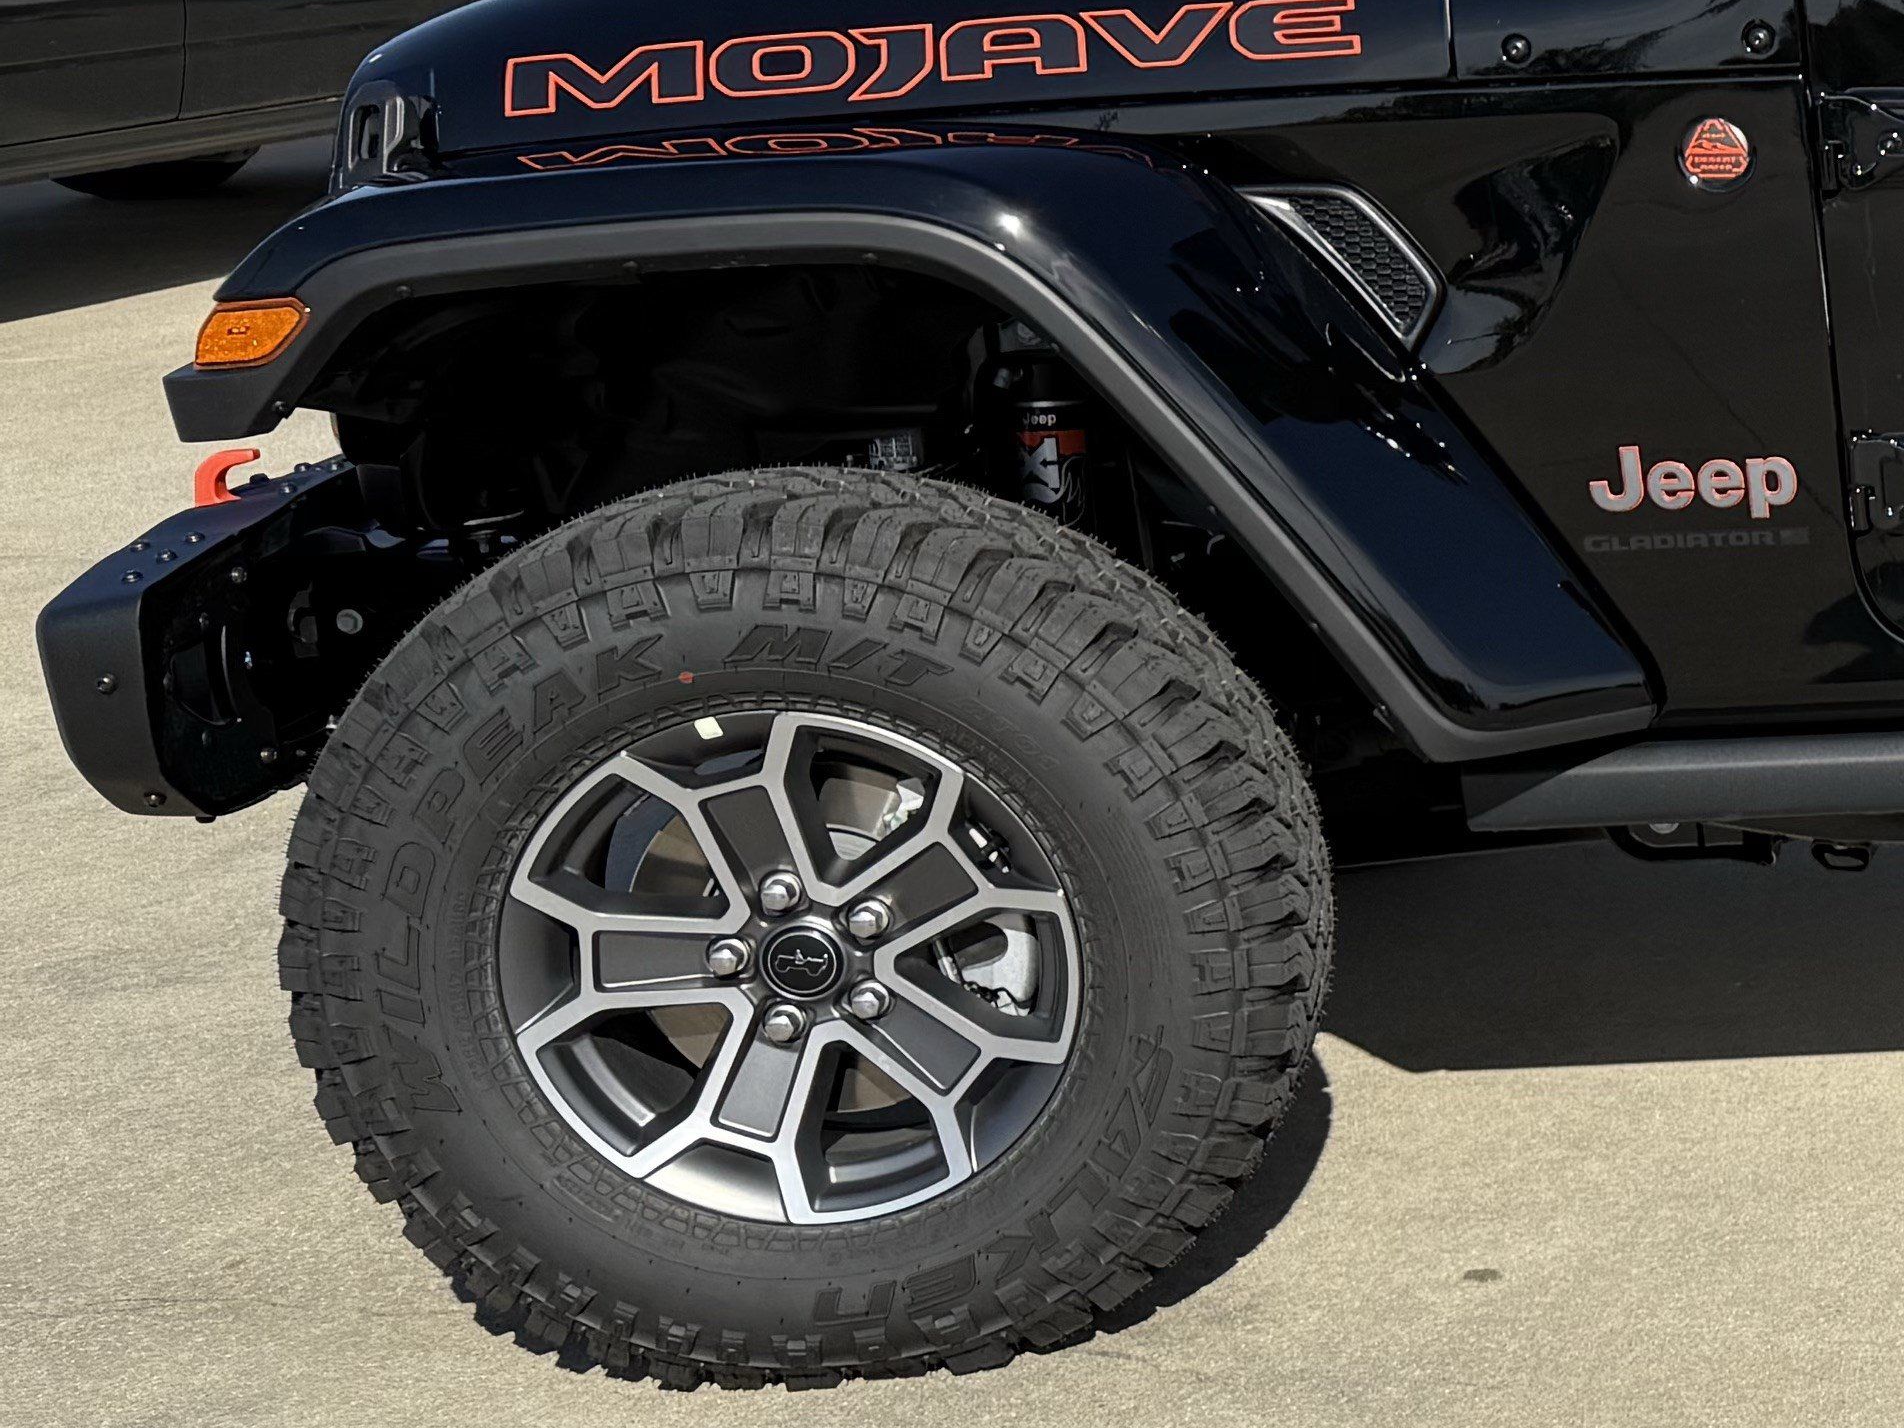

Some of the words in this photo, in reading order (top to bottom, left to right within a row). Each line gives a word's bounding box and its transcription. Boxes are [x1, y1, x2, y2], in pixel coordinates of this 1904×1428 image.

[1589, 445, 1797, 519] Jeep
[1583, 530, 1774, 553] GLADIATOR
[374, 634, 664, 1114] WILDPEAK
